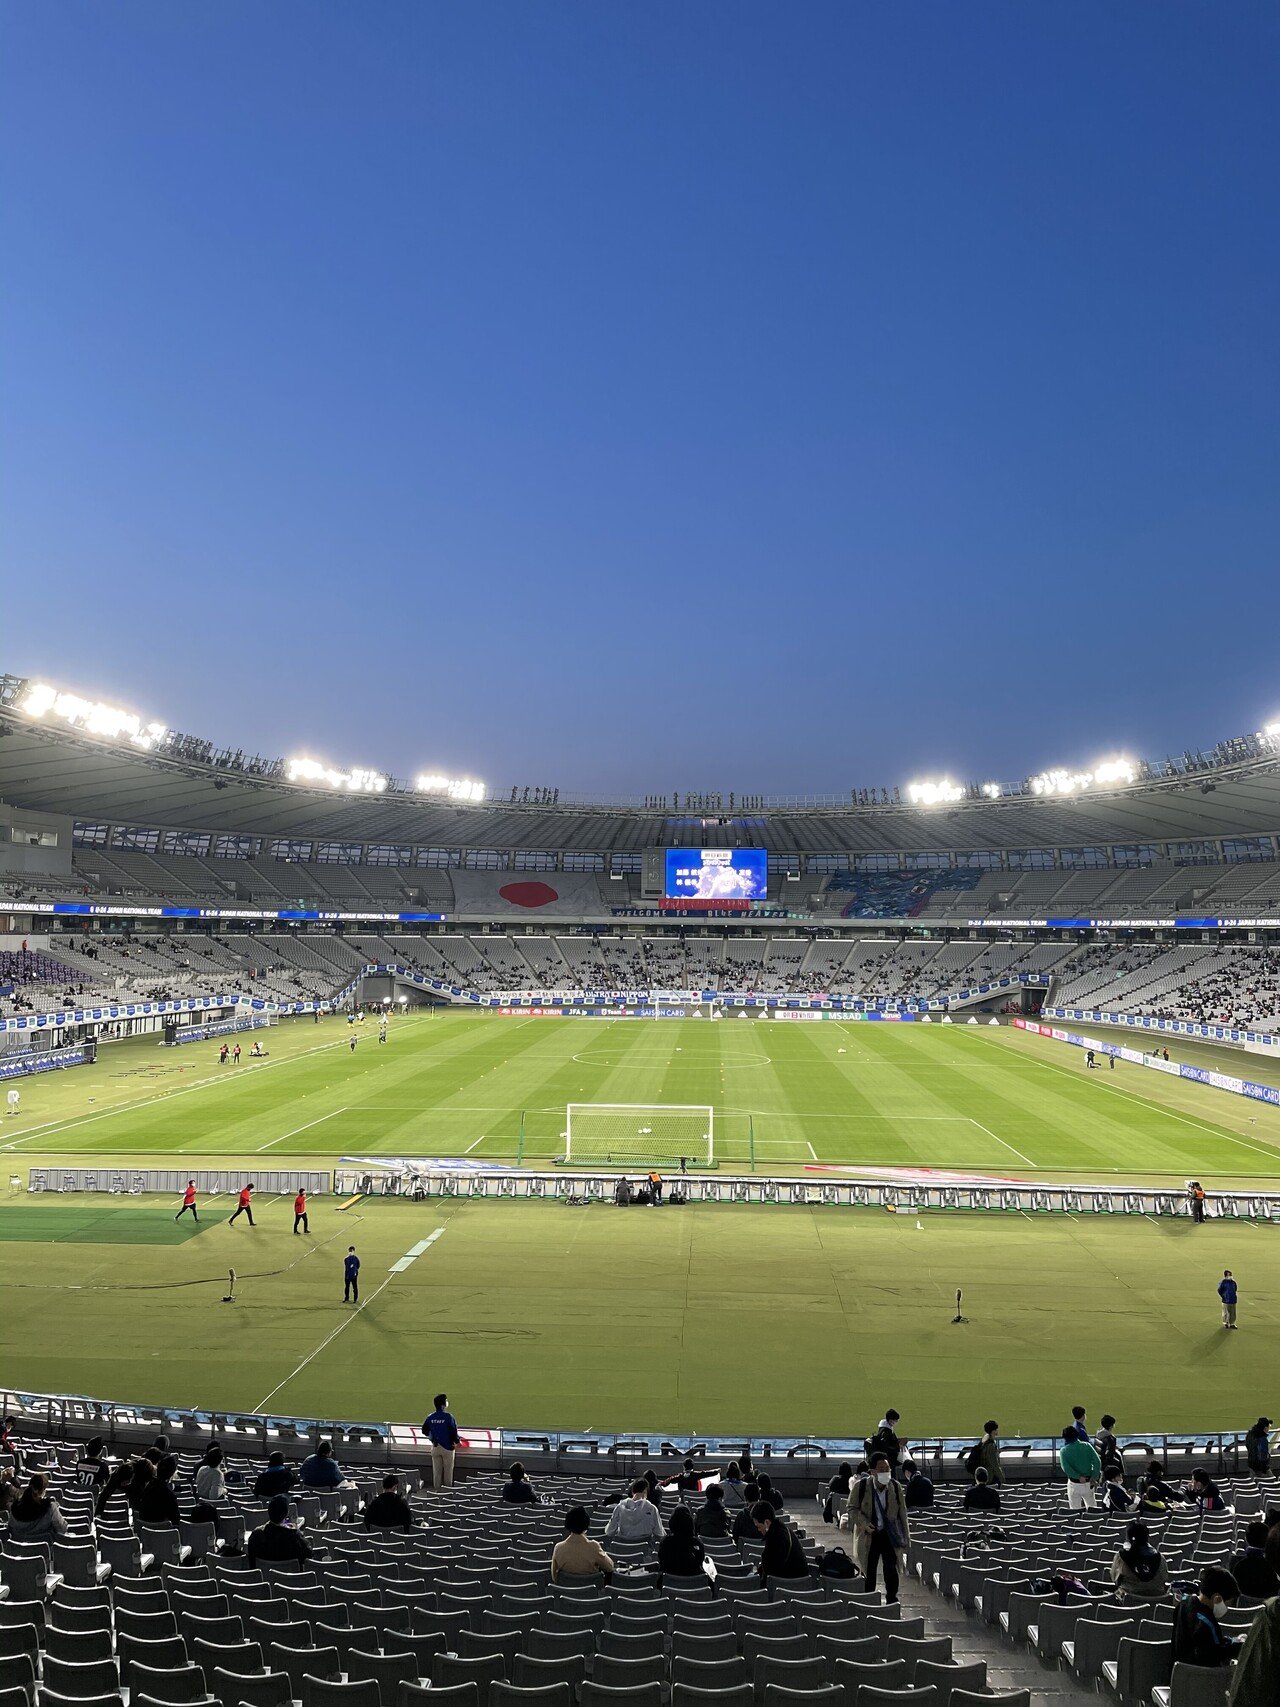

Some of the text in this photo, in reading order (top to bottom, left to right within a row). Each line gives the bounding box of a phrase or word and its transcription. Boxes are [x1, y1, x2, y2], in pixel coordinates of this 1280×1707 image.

[0, 902, 54, 912] APAN NATIONAL TEAM
[123, 907, 148, 915] NATIONAL
[586, 990, 610, 998] ULTRA
[620, 990, 648, 998] NIPPON
[641, 1009, 685, 1017] SAISON CARD
[828, 1012, 862, 1020] MS&AD
[1242, 1082, 1280, 1103] SAISON CARD
